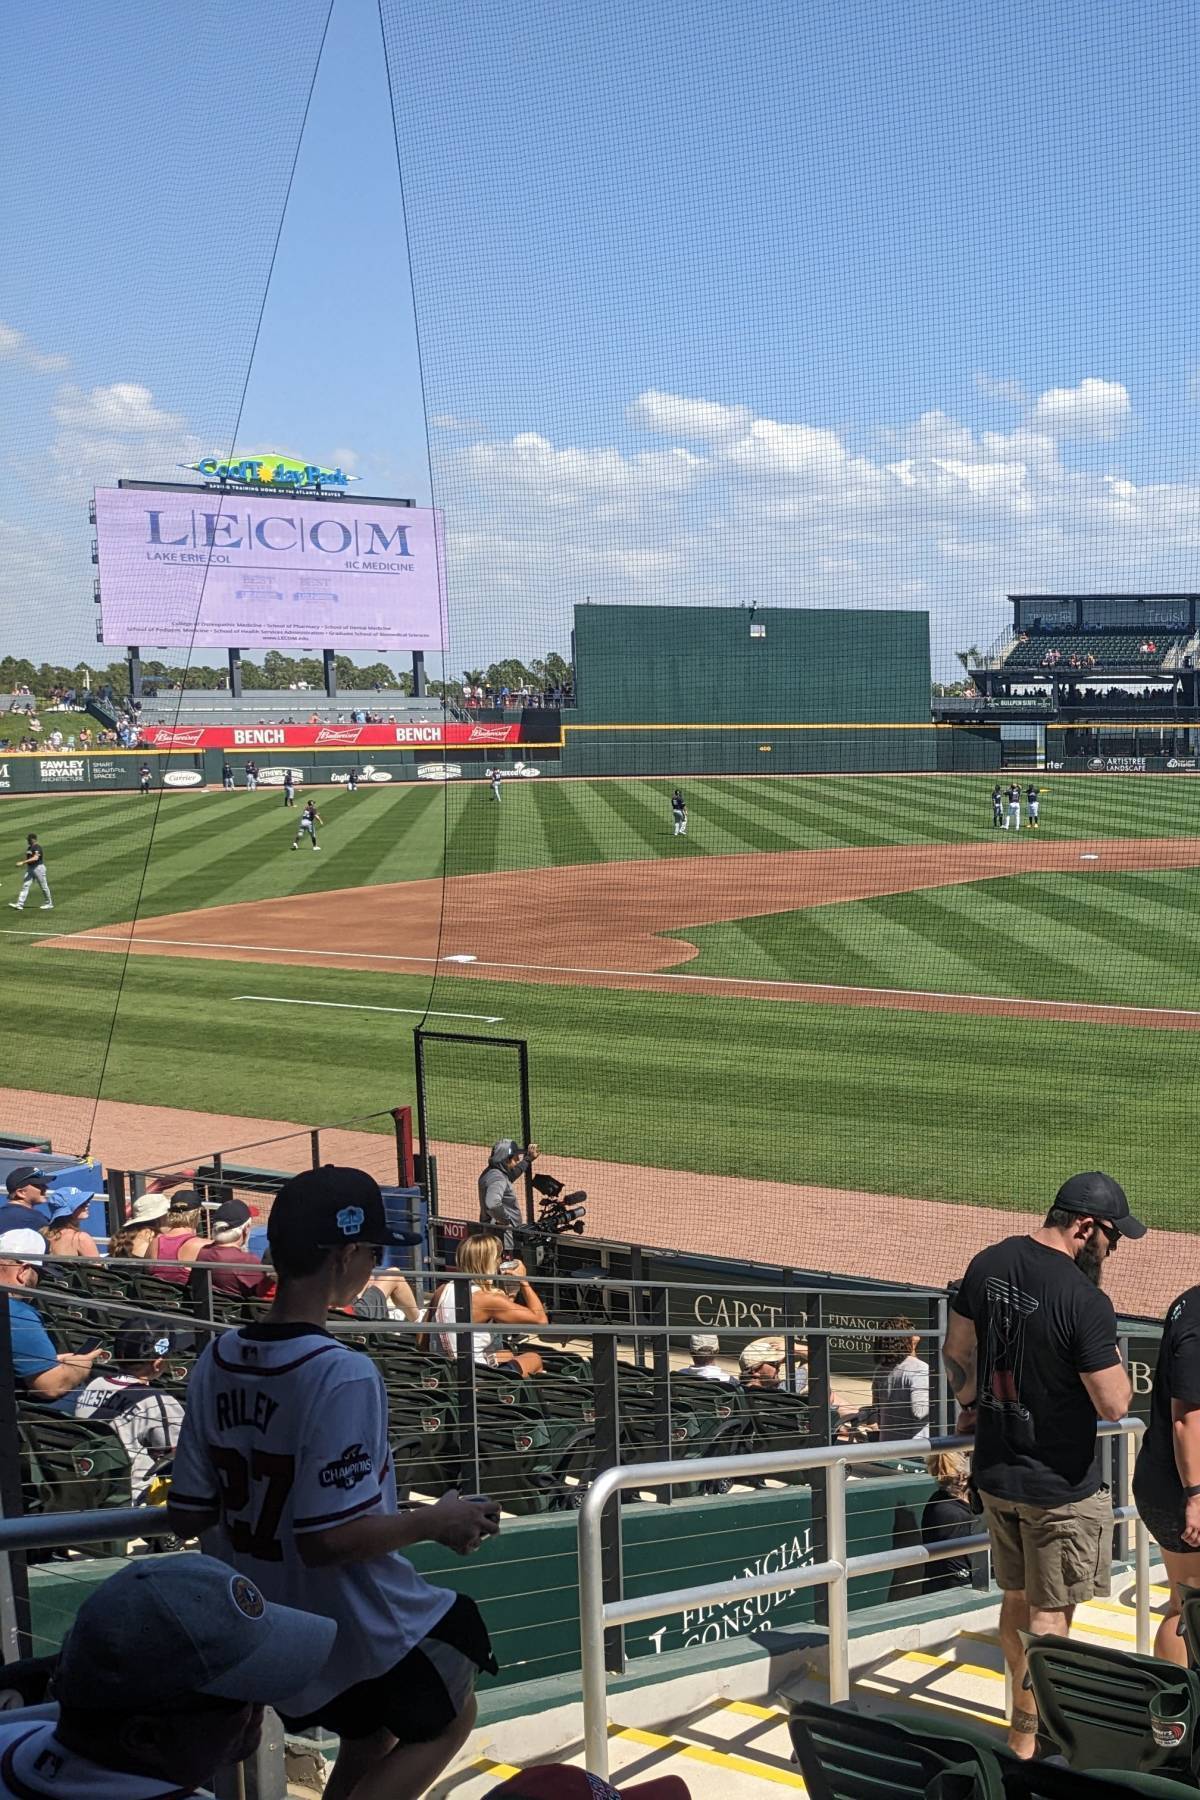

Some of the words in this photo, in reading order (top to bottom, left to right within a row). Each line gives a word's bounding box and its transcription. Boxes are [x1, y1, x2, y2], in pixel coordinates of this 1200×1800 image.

[304, 465, 349, 487] Park
[296, 489, 320, 497] ATLANTA
[146, 552, 178, 562] LAKE
[180, 553, 207, 563] ERIE
[362, 561, 415, 572] MEDICINE
[1147, 609, 1185, 622] Truist
[156, 732, 199, 742] Budweiser
[234, 729, 285, 745] BENCH
[321, 730, 360, 740] Budweiser
[395, 727, 442, 741] BENCH
[472, 728, 507, 738] Budweiser
[40, 760, 84, 769] FAWLEY
[41, 768, 84, 777] BRYANT
[444, 1224, 465, 1238] NOT
[829, 1337, 872, 1352] GROUP
[216, 1388, 279, 1435] RILEY
[322, 1458, 372, 1483] CHAMPIONS
[208, 1444, 296, 1562] 27
